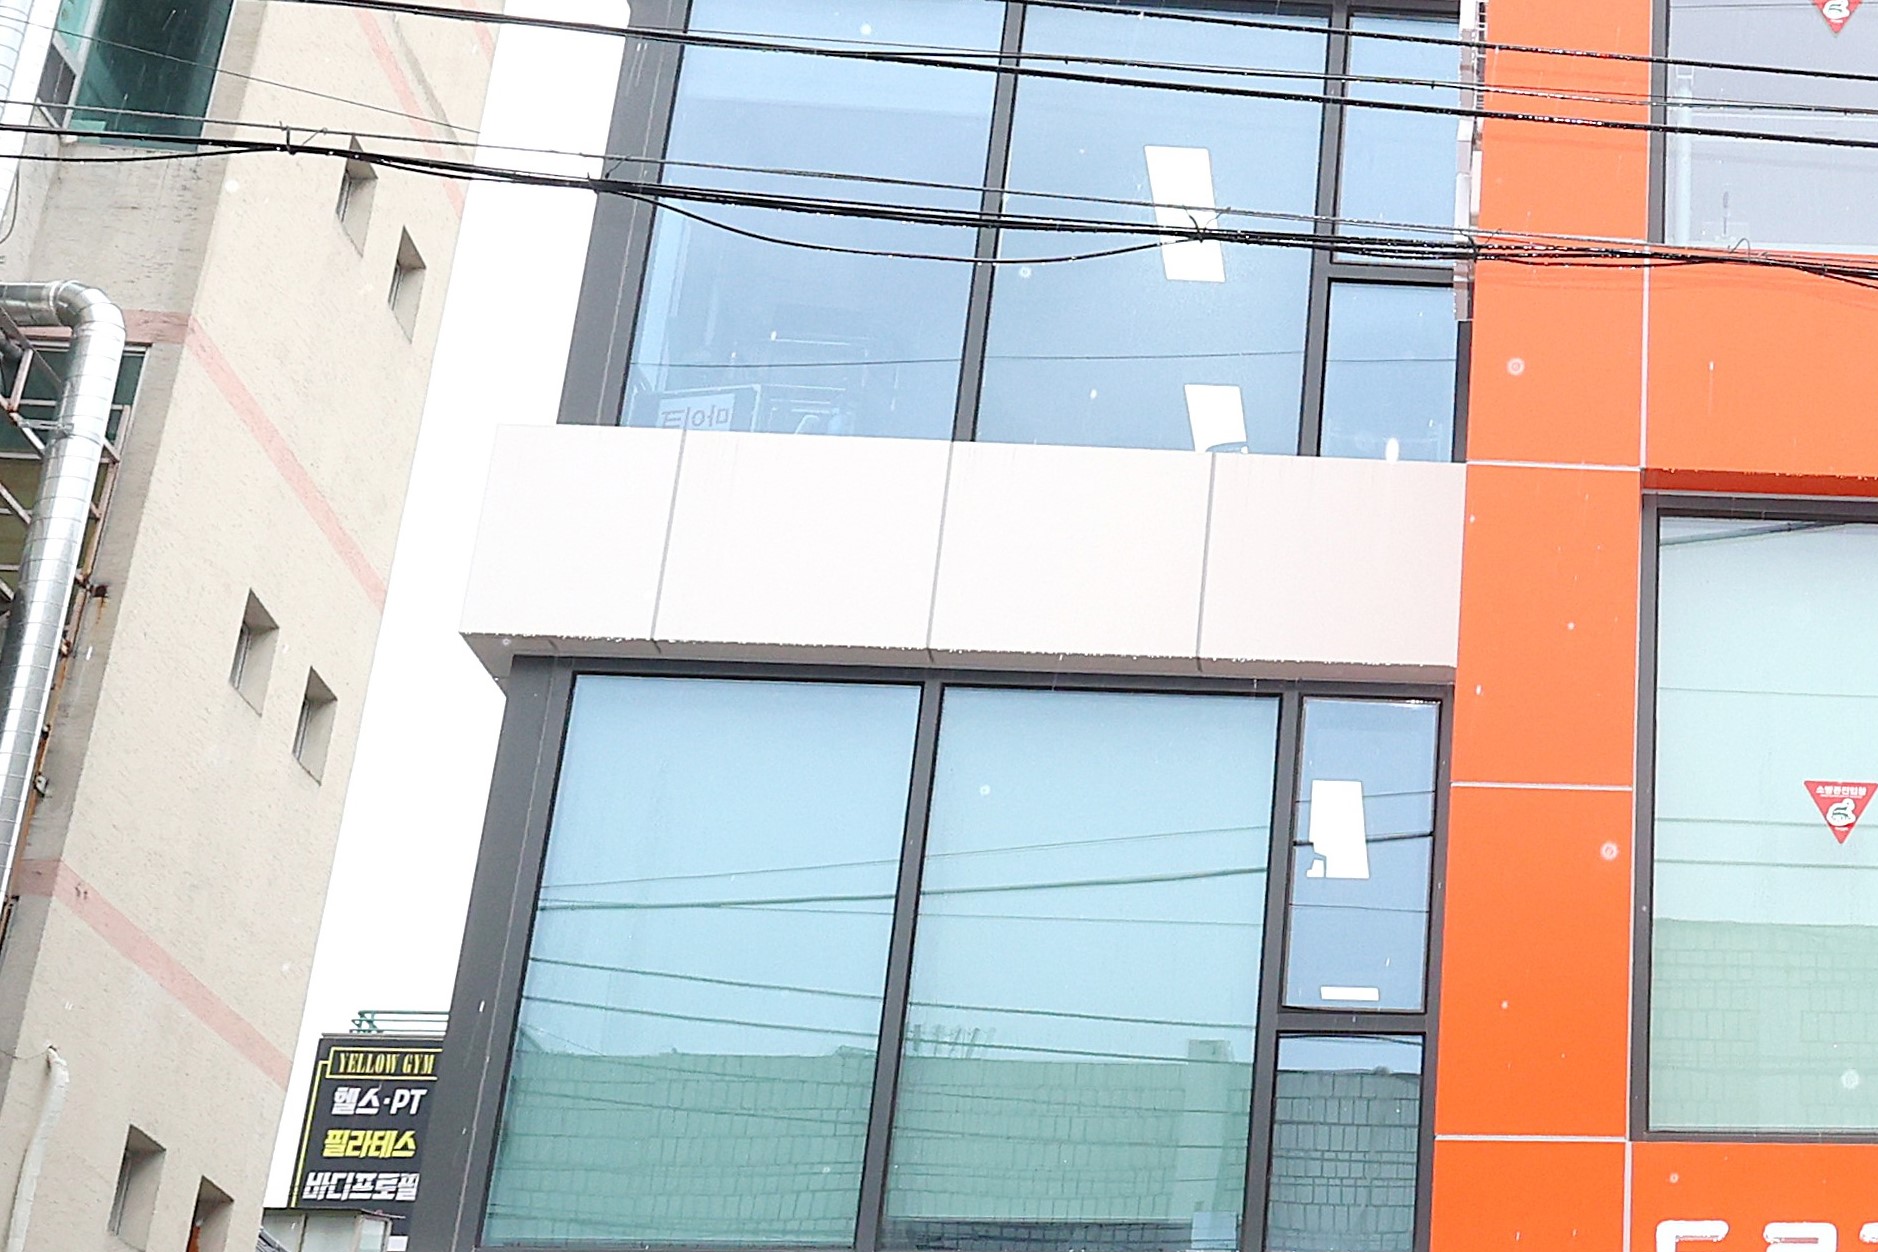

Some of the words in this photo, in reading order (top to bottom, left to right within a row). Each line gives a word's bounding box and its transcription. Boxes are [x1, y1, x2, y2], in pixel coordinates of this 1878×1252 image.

[338, 1053, 400, 1075] YELLOW
[403, 1053, 435, 1075] GYM
[322, 1129, 417, 1158] 필라테스
[302, 1172, 420, 1201] 바디프로필
